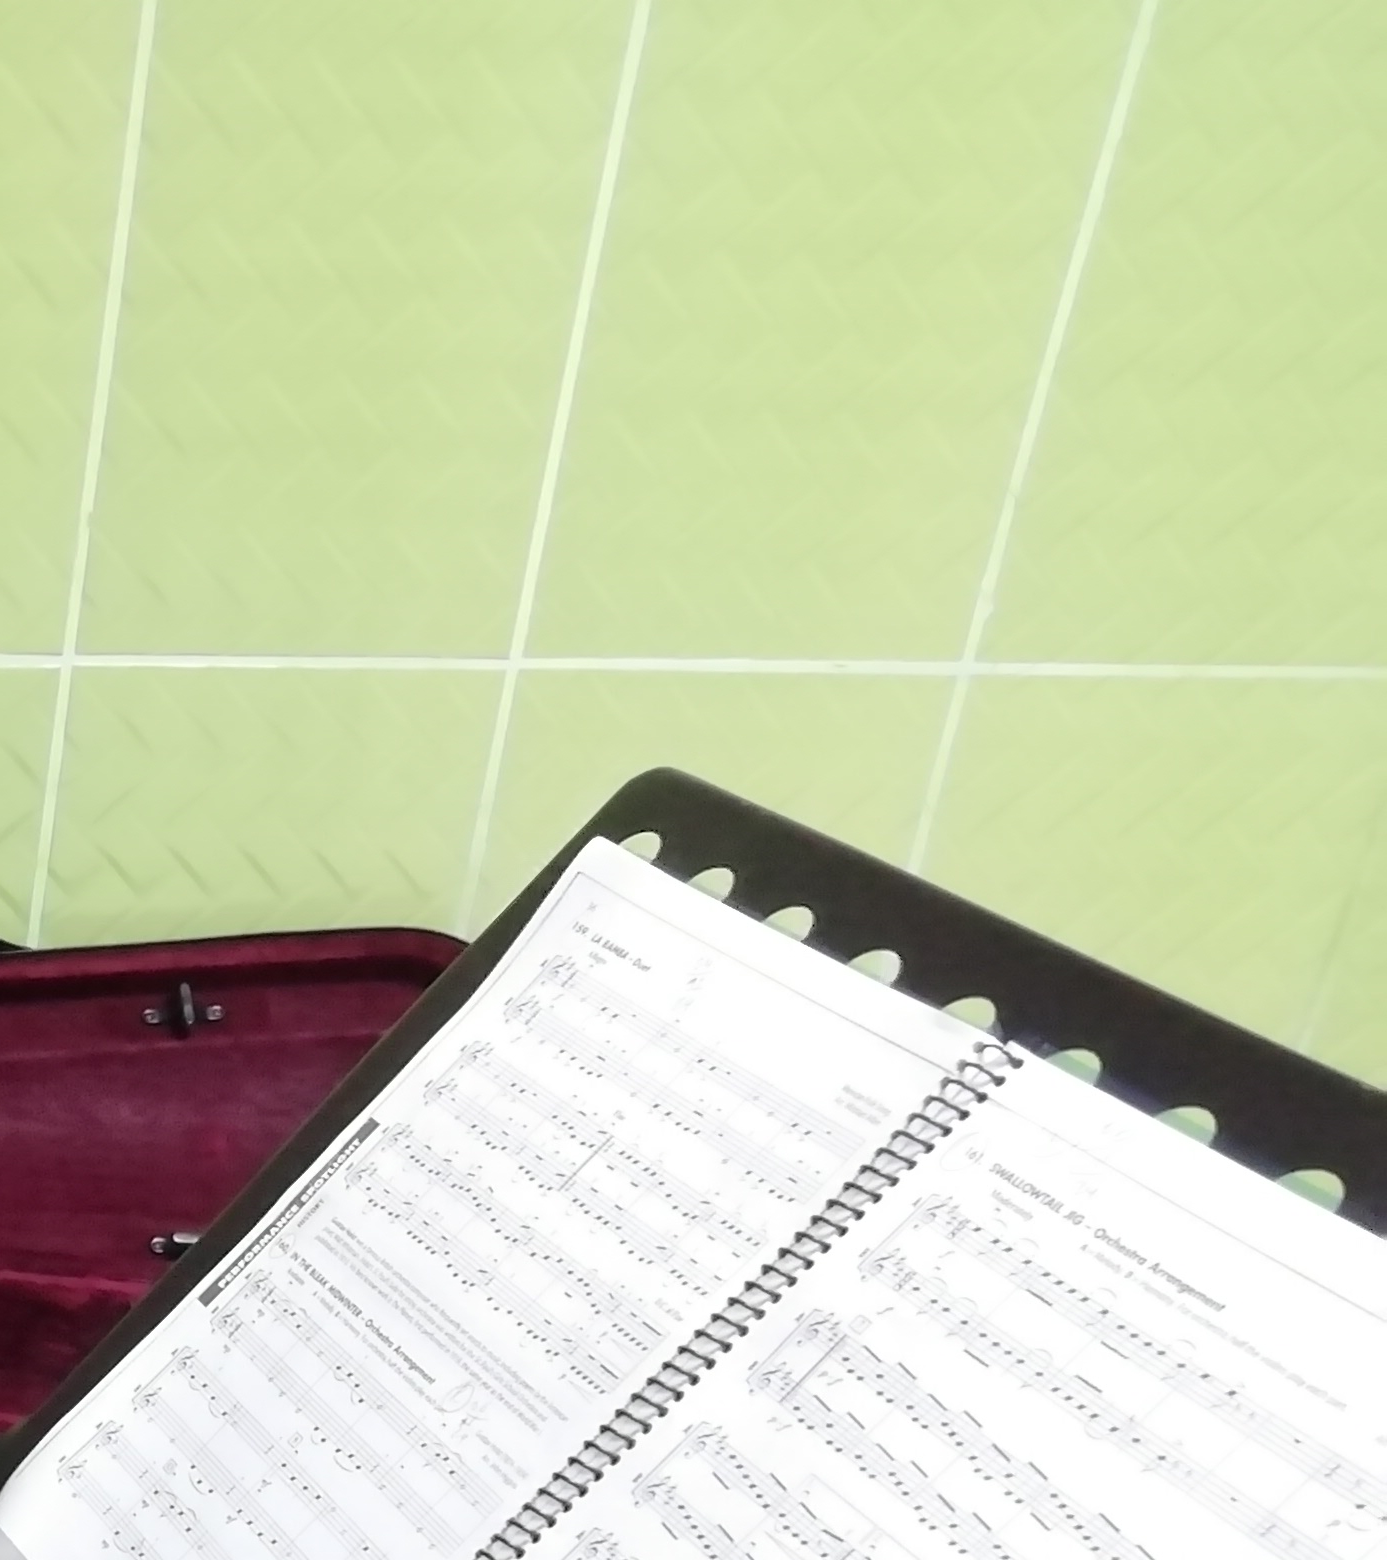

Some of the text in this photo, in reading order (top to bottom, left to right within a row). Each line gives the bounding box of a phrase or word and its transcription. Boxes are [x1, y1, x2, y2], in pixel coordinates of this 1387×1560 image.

[217, 1136, 363, 1290] PERFORMANCE SPOTLIGHT
[988, 1162, 1065, 1215] SWALLOWTAIL
[1063, 1207, 1085, 1227] JIG
[1093, 1226, 1147, 1267] Orchestra
[1146, 1261, 1226, 1313] Arrangement
[364, 1318, 395, 1349] Orchestra
[393, 1344, 437, 1386] Arrangement
